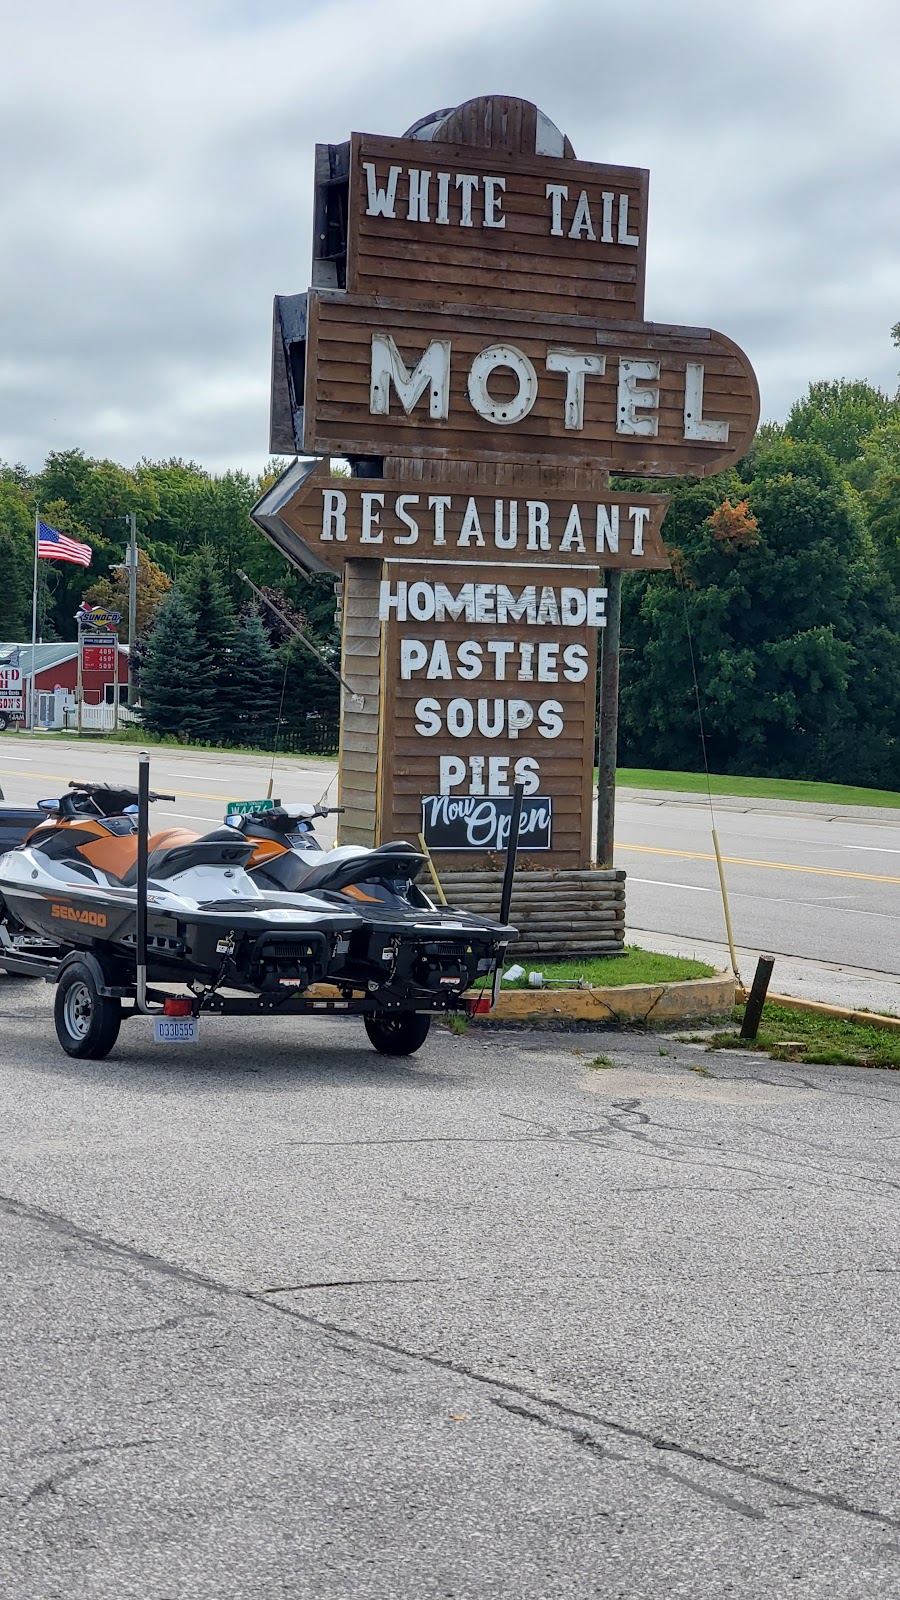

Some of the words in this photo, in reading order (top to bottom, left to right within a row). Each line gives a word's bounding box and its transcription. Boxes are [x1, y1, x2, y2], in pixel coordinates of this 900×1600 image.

[362, 162, 506, 228] WHITE
[545, 184, 639, 246] TAIL
[370, 333, 729, 442] MOTEL
[320, 489, 650, 556] RESTAURANT
[378, 580, 608, 627] HOMEMADE
[400, 639, 588, 683] PASTIES
[414, 698, 564, 739] SOUPS
[439, 756, 540, 796] PIES
[422, 796, 475, 827] Now
[464, 801, 550, 850] Open
